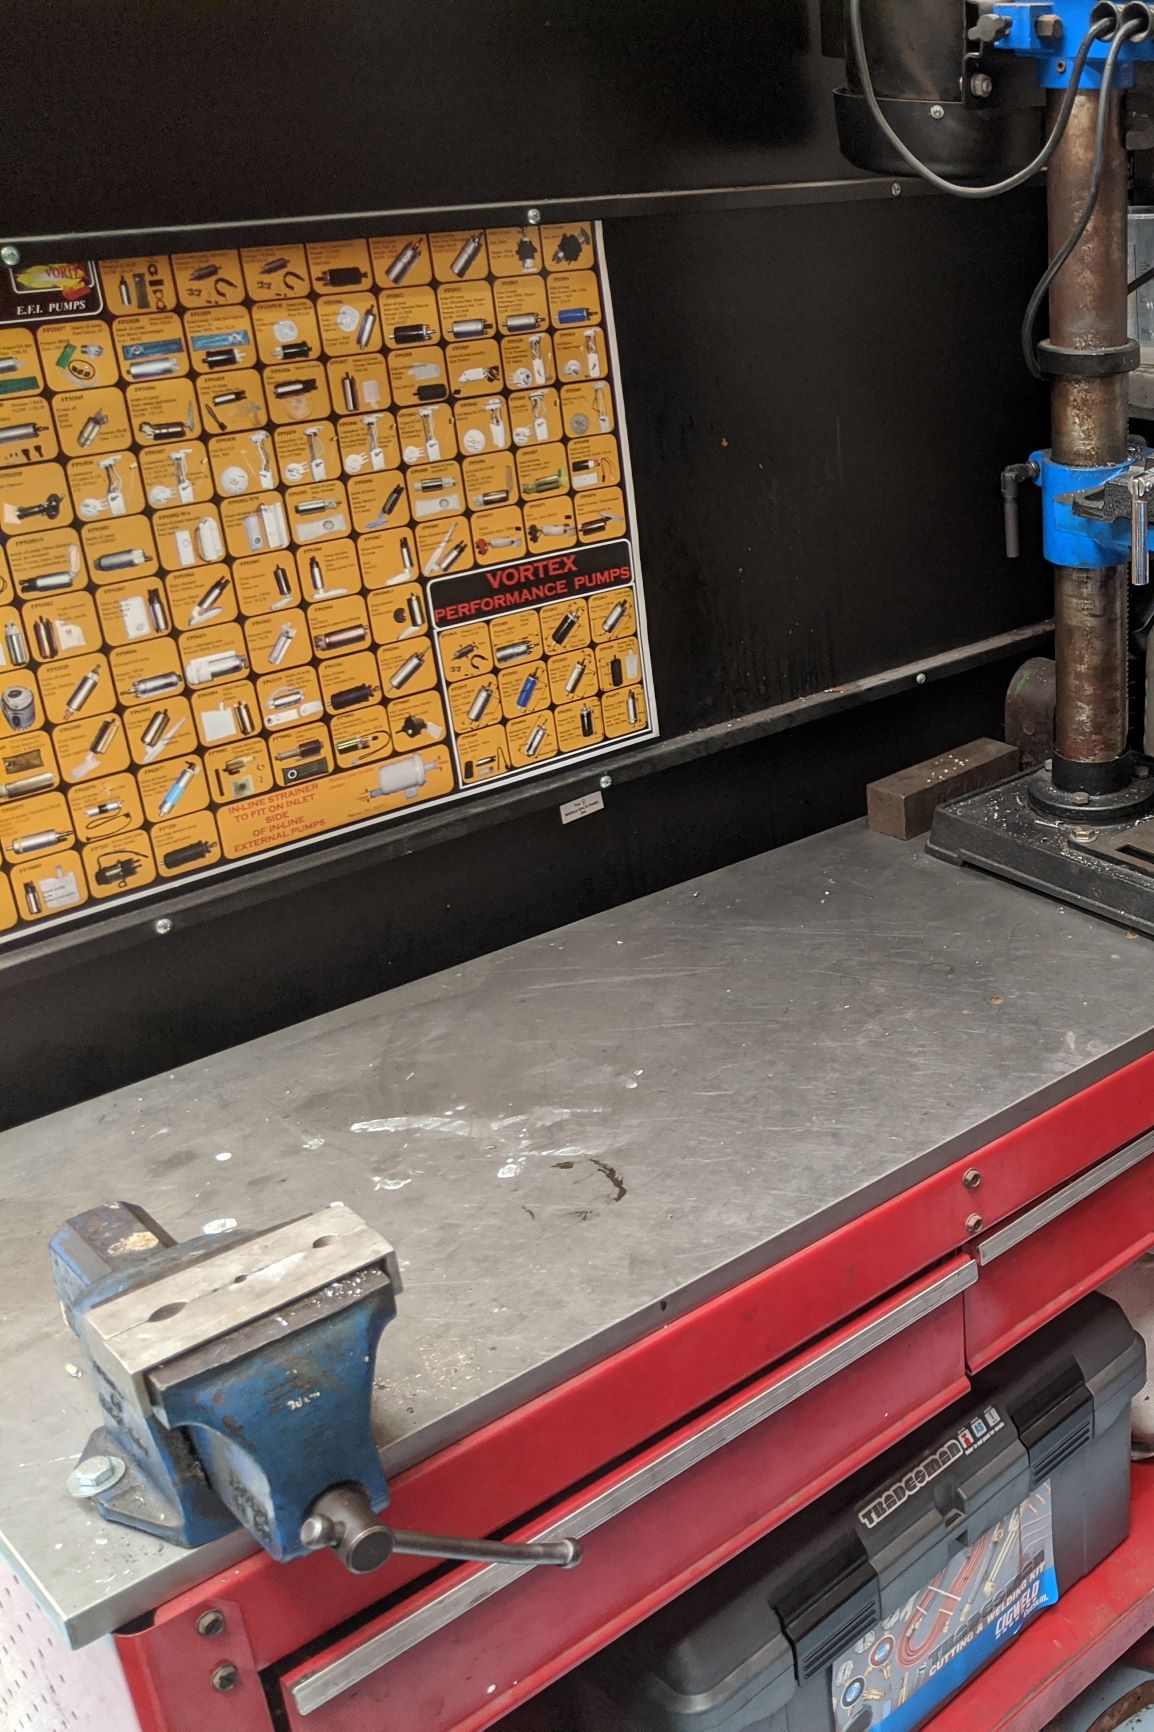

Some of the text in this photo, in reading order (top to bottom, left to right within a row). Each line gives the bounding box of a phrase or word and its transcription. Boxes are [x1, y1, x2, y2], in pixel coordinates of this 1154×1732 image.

[17, 301, 86, 316] E.F.I. PUMPS
[486, 555, 577, 589] VORTEX
[434, 567, 631, 623] PERFORMANCE PUMPS
[228, 796, 266, 815] IN-LINE
[267, 783, 319, 806] STRAINER
[234, 794, 316, 823] TO FIT ON INLET
[252, 816, 305, 838] OF IN-LINE
[265, 811, 290, 824] SIDE
[233, 818, 326, 852] EXTERNAL PUMPS
[859, 1440, 963, 1528] TRADESMAN
[929, 1633, 974, 1676] CUTTING
[986, 1582, 1027, 1623] WELDING
[1028, 1562, 1045, 1584] KIT
